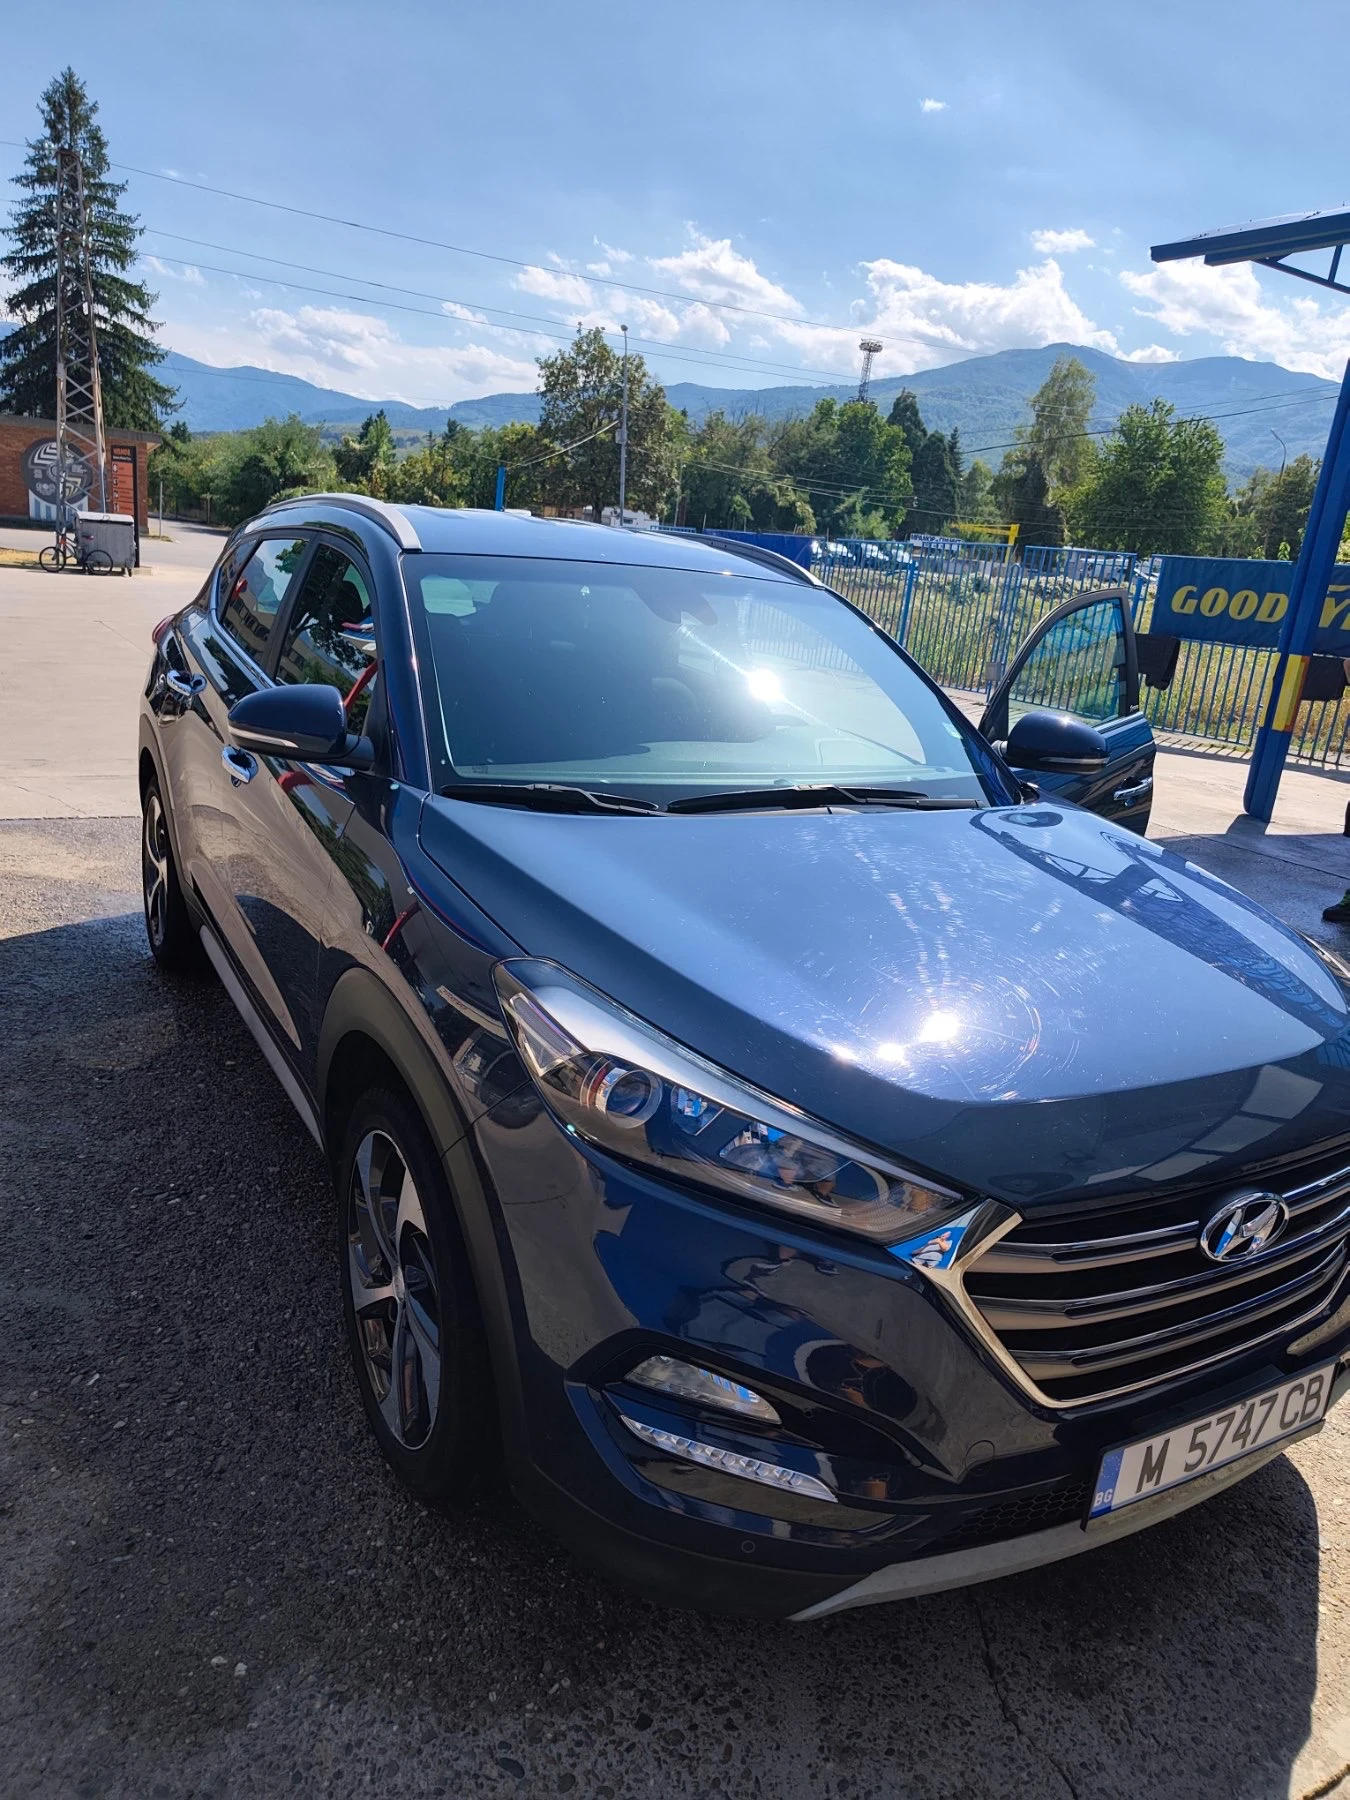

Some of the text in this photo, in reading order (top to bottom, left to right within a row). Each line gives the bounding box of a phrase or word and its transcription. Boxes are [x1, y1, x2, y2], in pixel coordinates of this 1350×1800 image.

[1171, 585, 1289, 623] GOOD
[1135, 1374, 1325, 1494] M 5747 CB
[1093, 1488, 1113, 1507] BG
